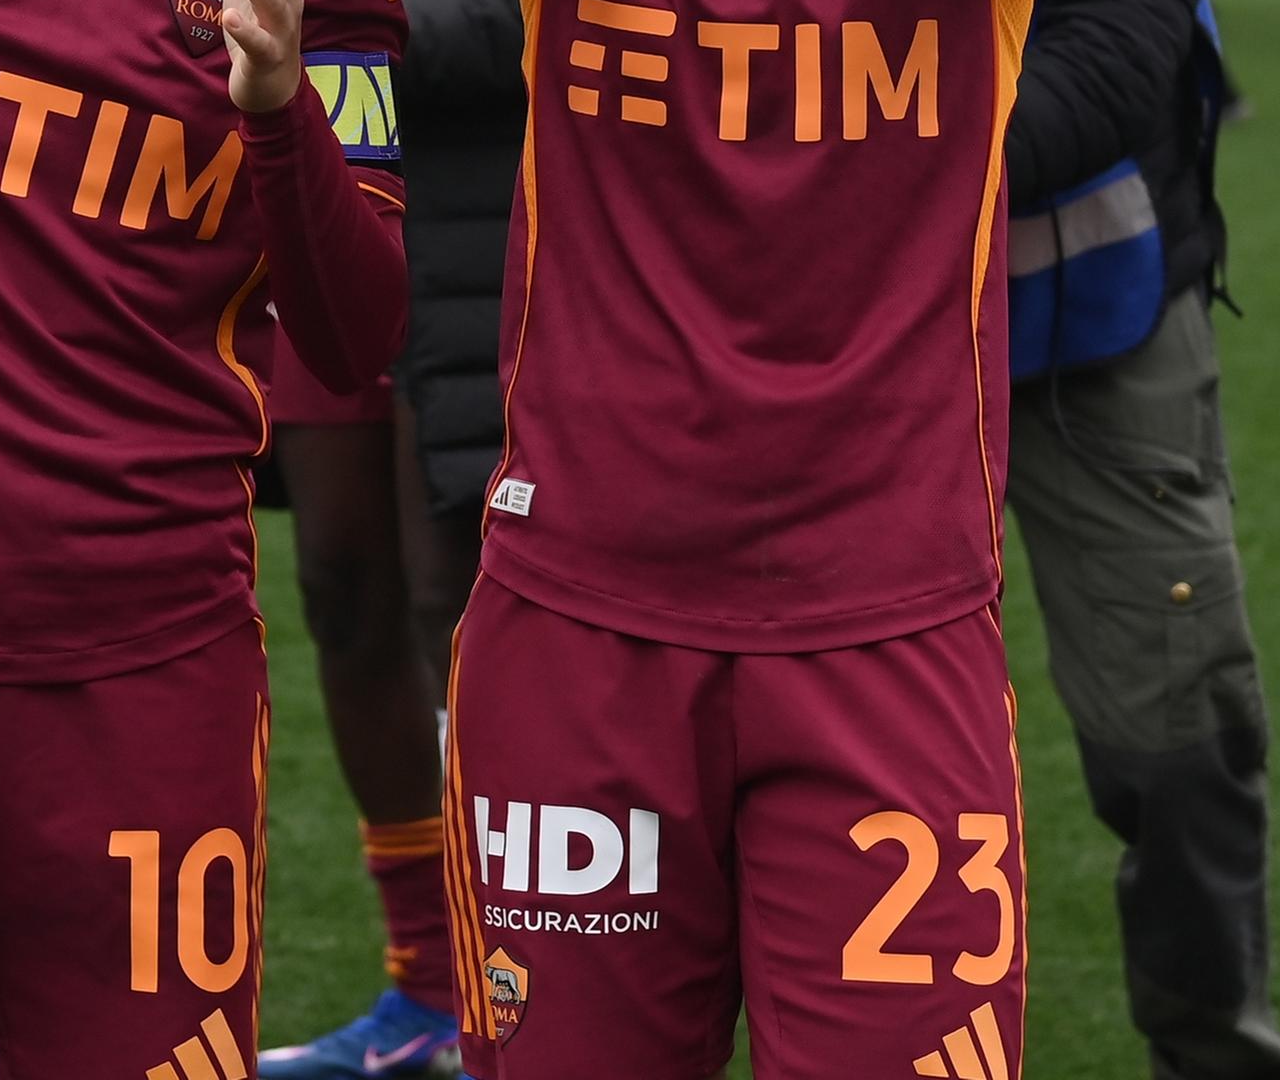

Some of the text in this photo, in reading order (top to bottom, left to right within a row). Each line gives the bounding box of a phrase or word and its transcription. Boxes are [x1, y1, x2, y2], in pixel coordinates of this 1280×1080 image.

[190, 25, 215, 42] 1927
[697, 19, 940, 142] TIM
[473, 795, 660, 895] HDI
[842, 810, 1016, 986] 23
[108, 827, 249, 993] 10
[485, 904, 659, 934] SSICURAZIONI
